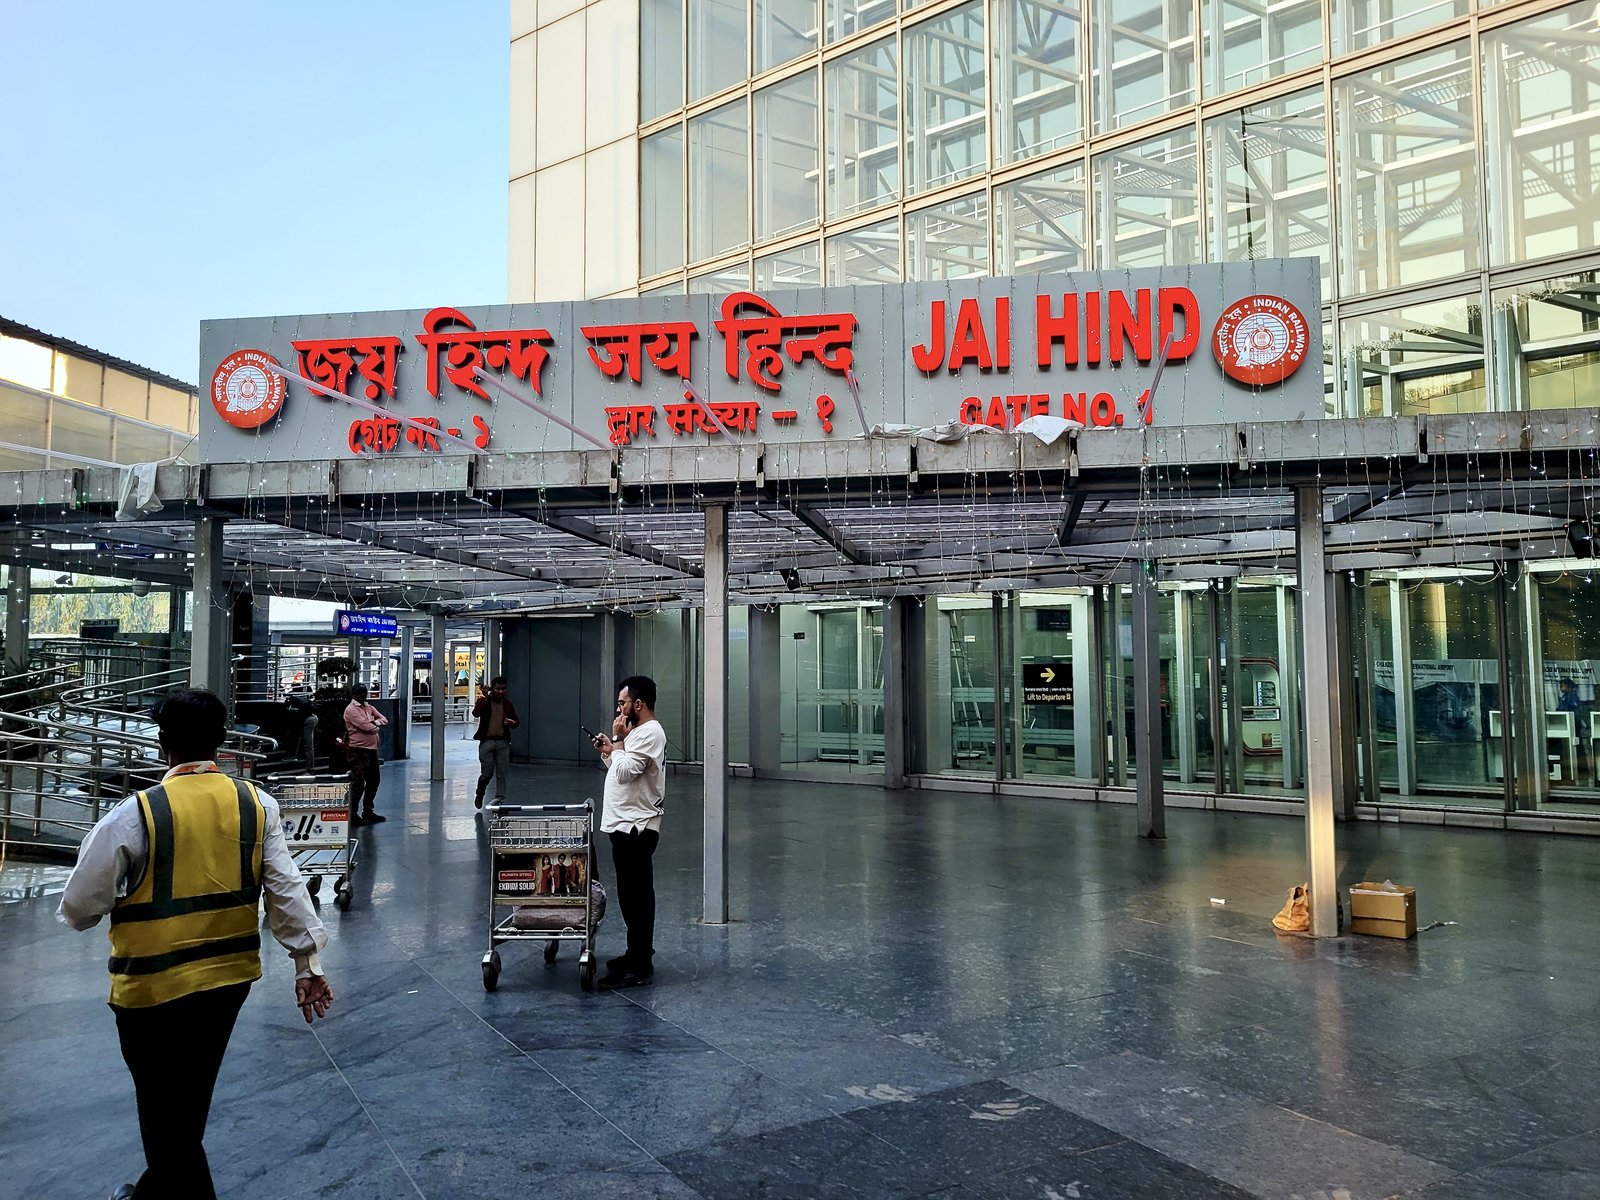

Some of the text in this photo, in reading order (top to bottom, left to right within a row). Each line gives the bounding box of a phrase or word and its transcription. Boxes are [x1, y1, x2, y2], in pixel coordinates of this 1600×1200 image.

[291, 306, 554, 401] জয় হিন্দ
[580, 291, 858, 391] जय हिन्द
[911, 286, 1201, 372] JAI HIND
[1254, 299, 1305, 361] INDIAN RAILWAYS
[245, 353, 281, 411] INDIA AILWAYS
[348, 413, 399, 454] গেট
[604, 406, 657, 446] द्वार
[662, 391, 760, 436] संख्या
[959, 394, 1050, 431] GATE
[1063, 392, 1124, 428] NO.
[1042, 693, 1066, 702] Departure
[519, 882, 535, 890] SOLID
